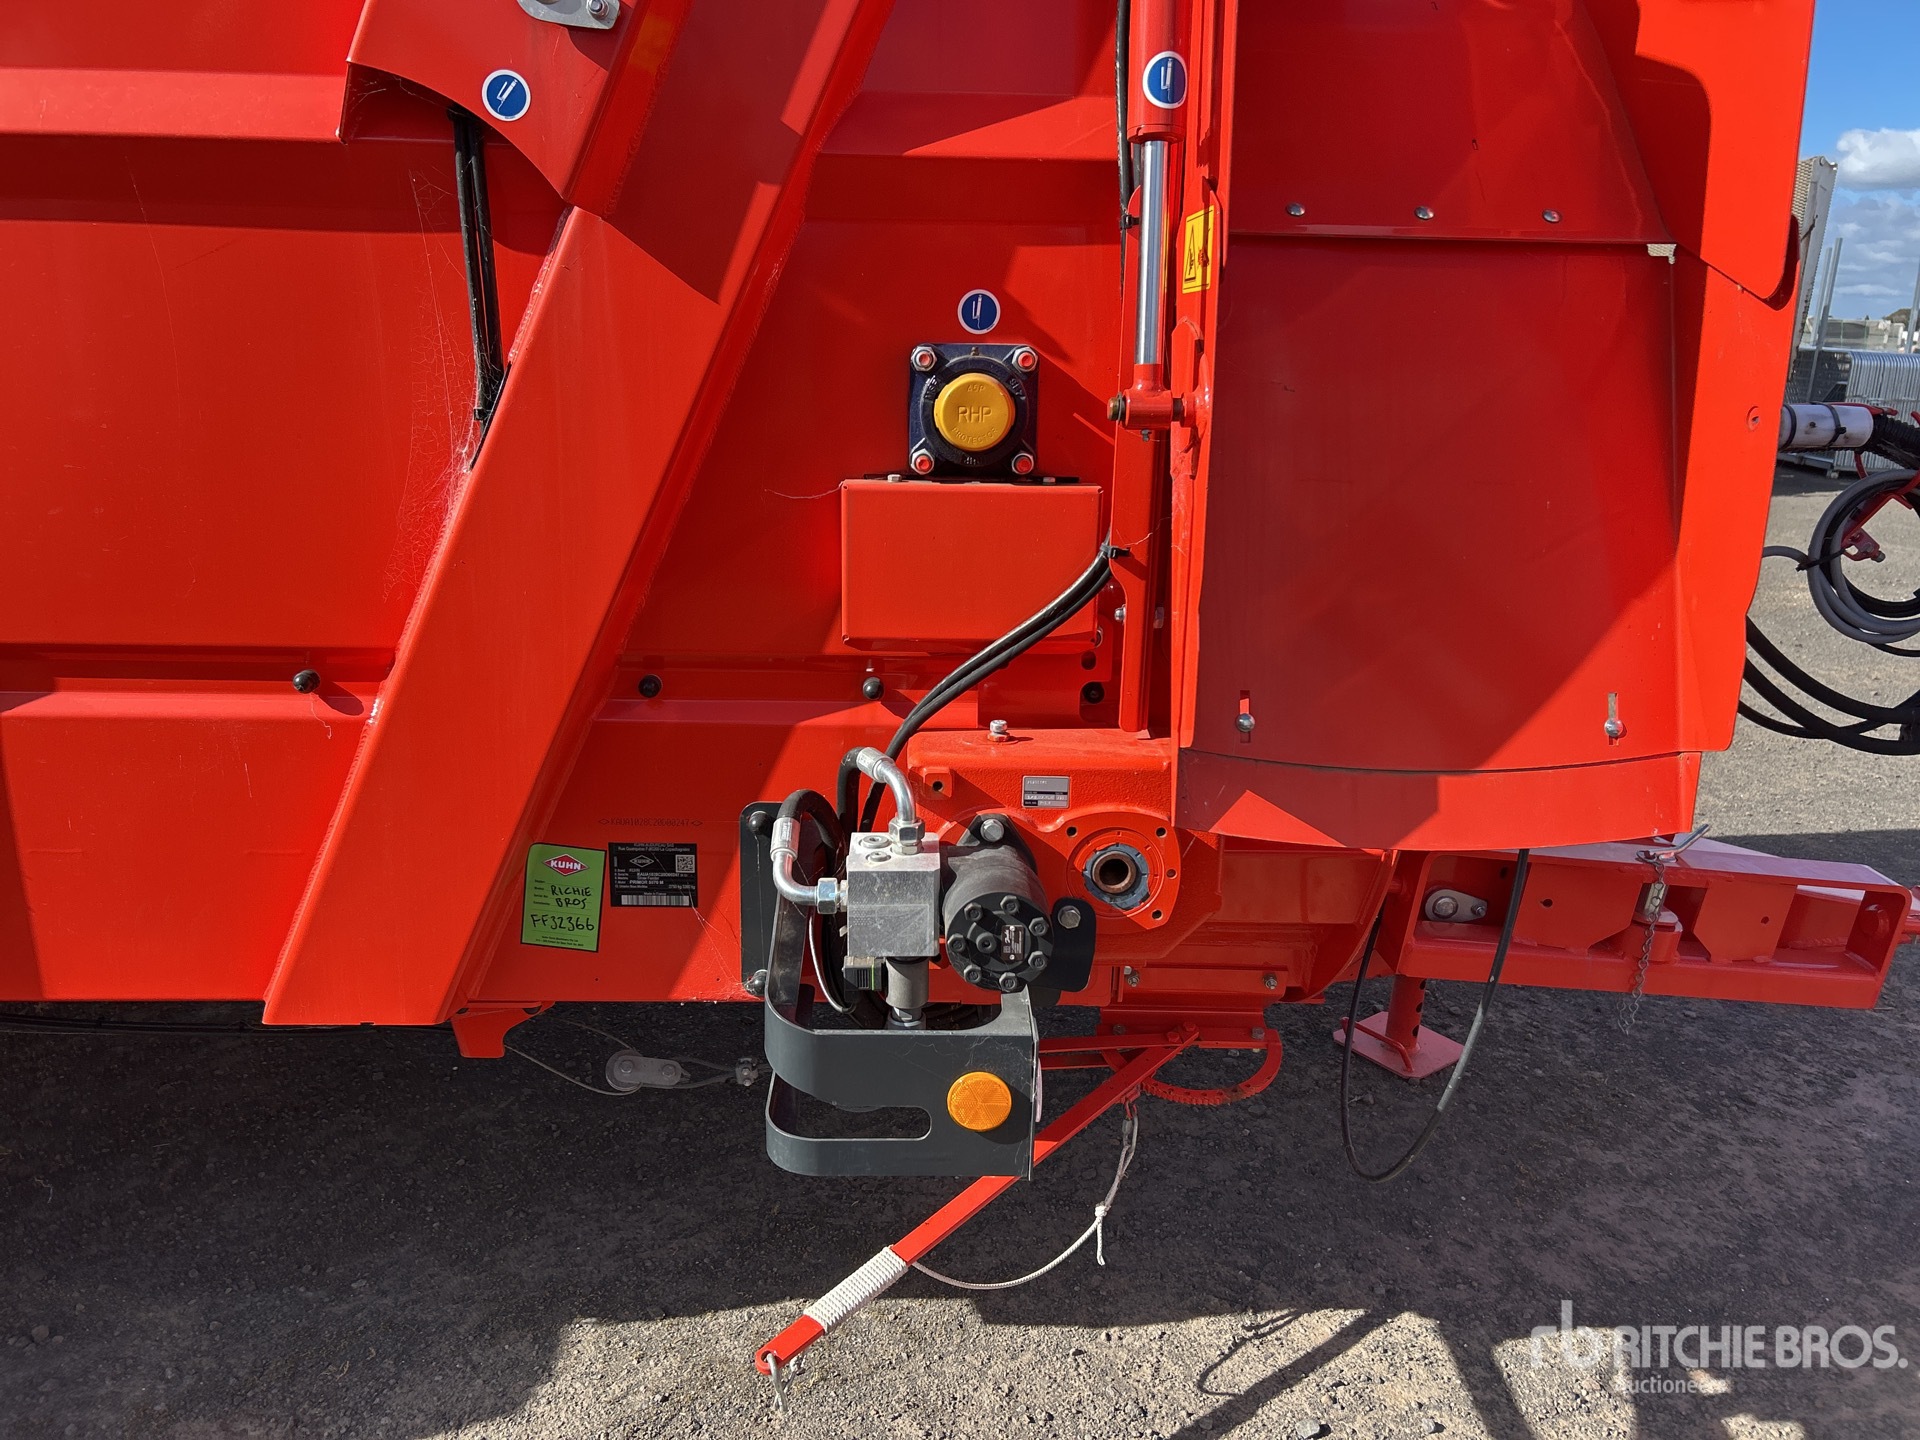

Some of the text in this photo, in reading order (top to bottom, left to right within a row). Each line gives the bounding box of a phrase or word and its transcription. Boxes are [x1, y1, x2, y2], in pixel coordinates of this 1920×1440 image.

[958, 405, 993, 424] RHP
[951, 426, 998, 445] PROTECTOR
[550, 860, 581, 870] KUHN
[550, 884, 592, 897] RICHIE
[556, 897, 588, 909] BROS
[530, 913, 595, 932] FF32366
